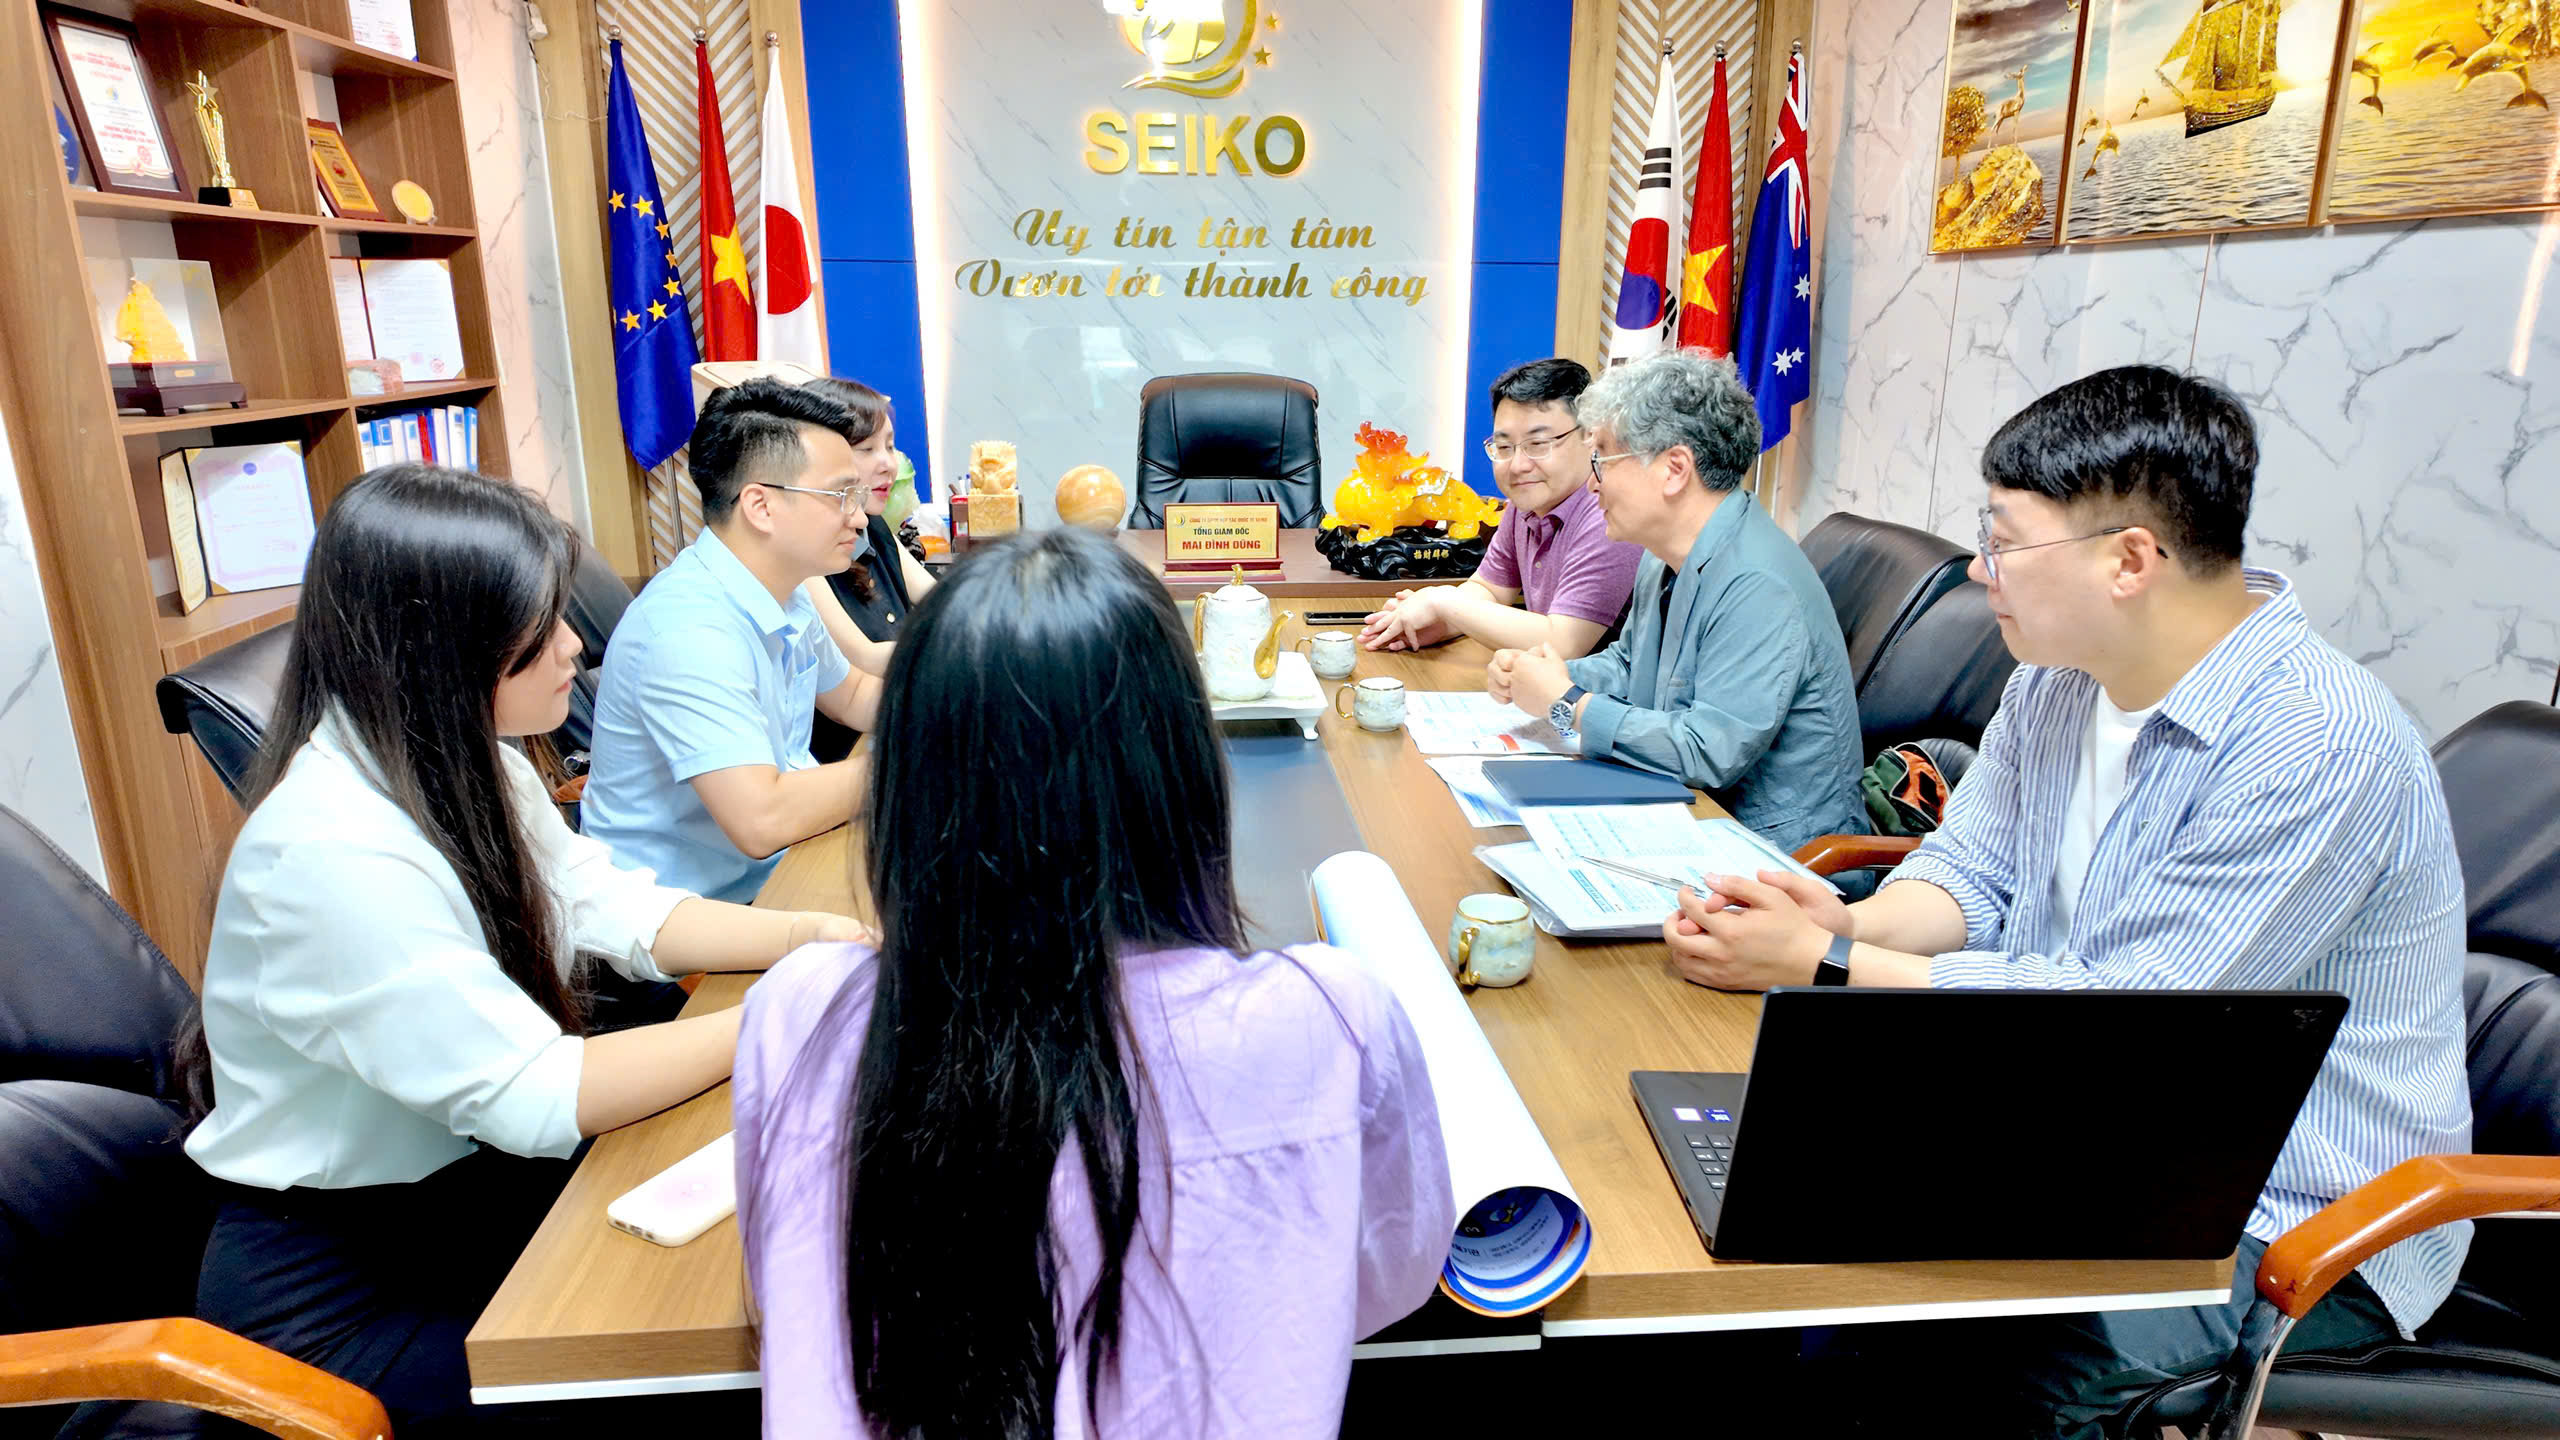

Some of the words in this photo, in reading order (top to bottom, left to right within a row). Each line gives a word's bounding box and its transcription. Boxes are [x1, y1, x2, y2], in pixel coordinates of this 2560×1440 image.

[1085, 111, 1306, 176] SEIKO
[1013, 208, 1092, 256] Uy
[1114, 216, 1177, 248] tín
[1197, 216, 1270, 257] tận
[1290, 216, 1376, 248] tâm
[954, 258, 1087, 297] Vươn
[1104, 265, 1165, 297] tới
[1184, 261, 1312, 298] thành
[1330, 266, 1430, 307] công
[1182, 540, 1202, 550] MAI
[1205, 538, 1230, 550] ĐÌNH
